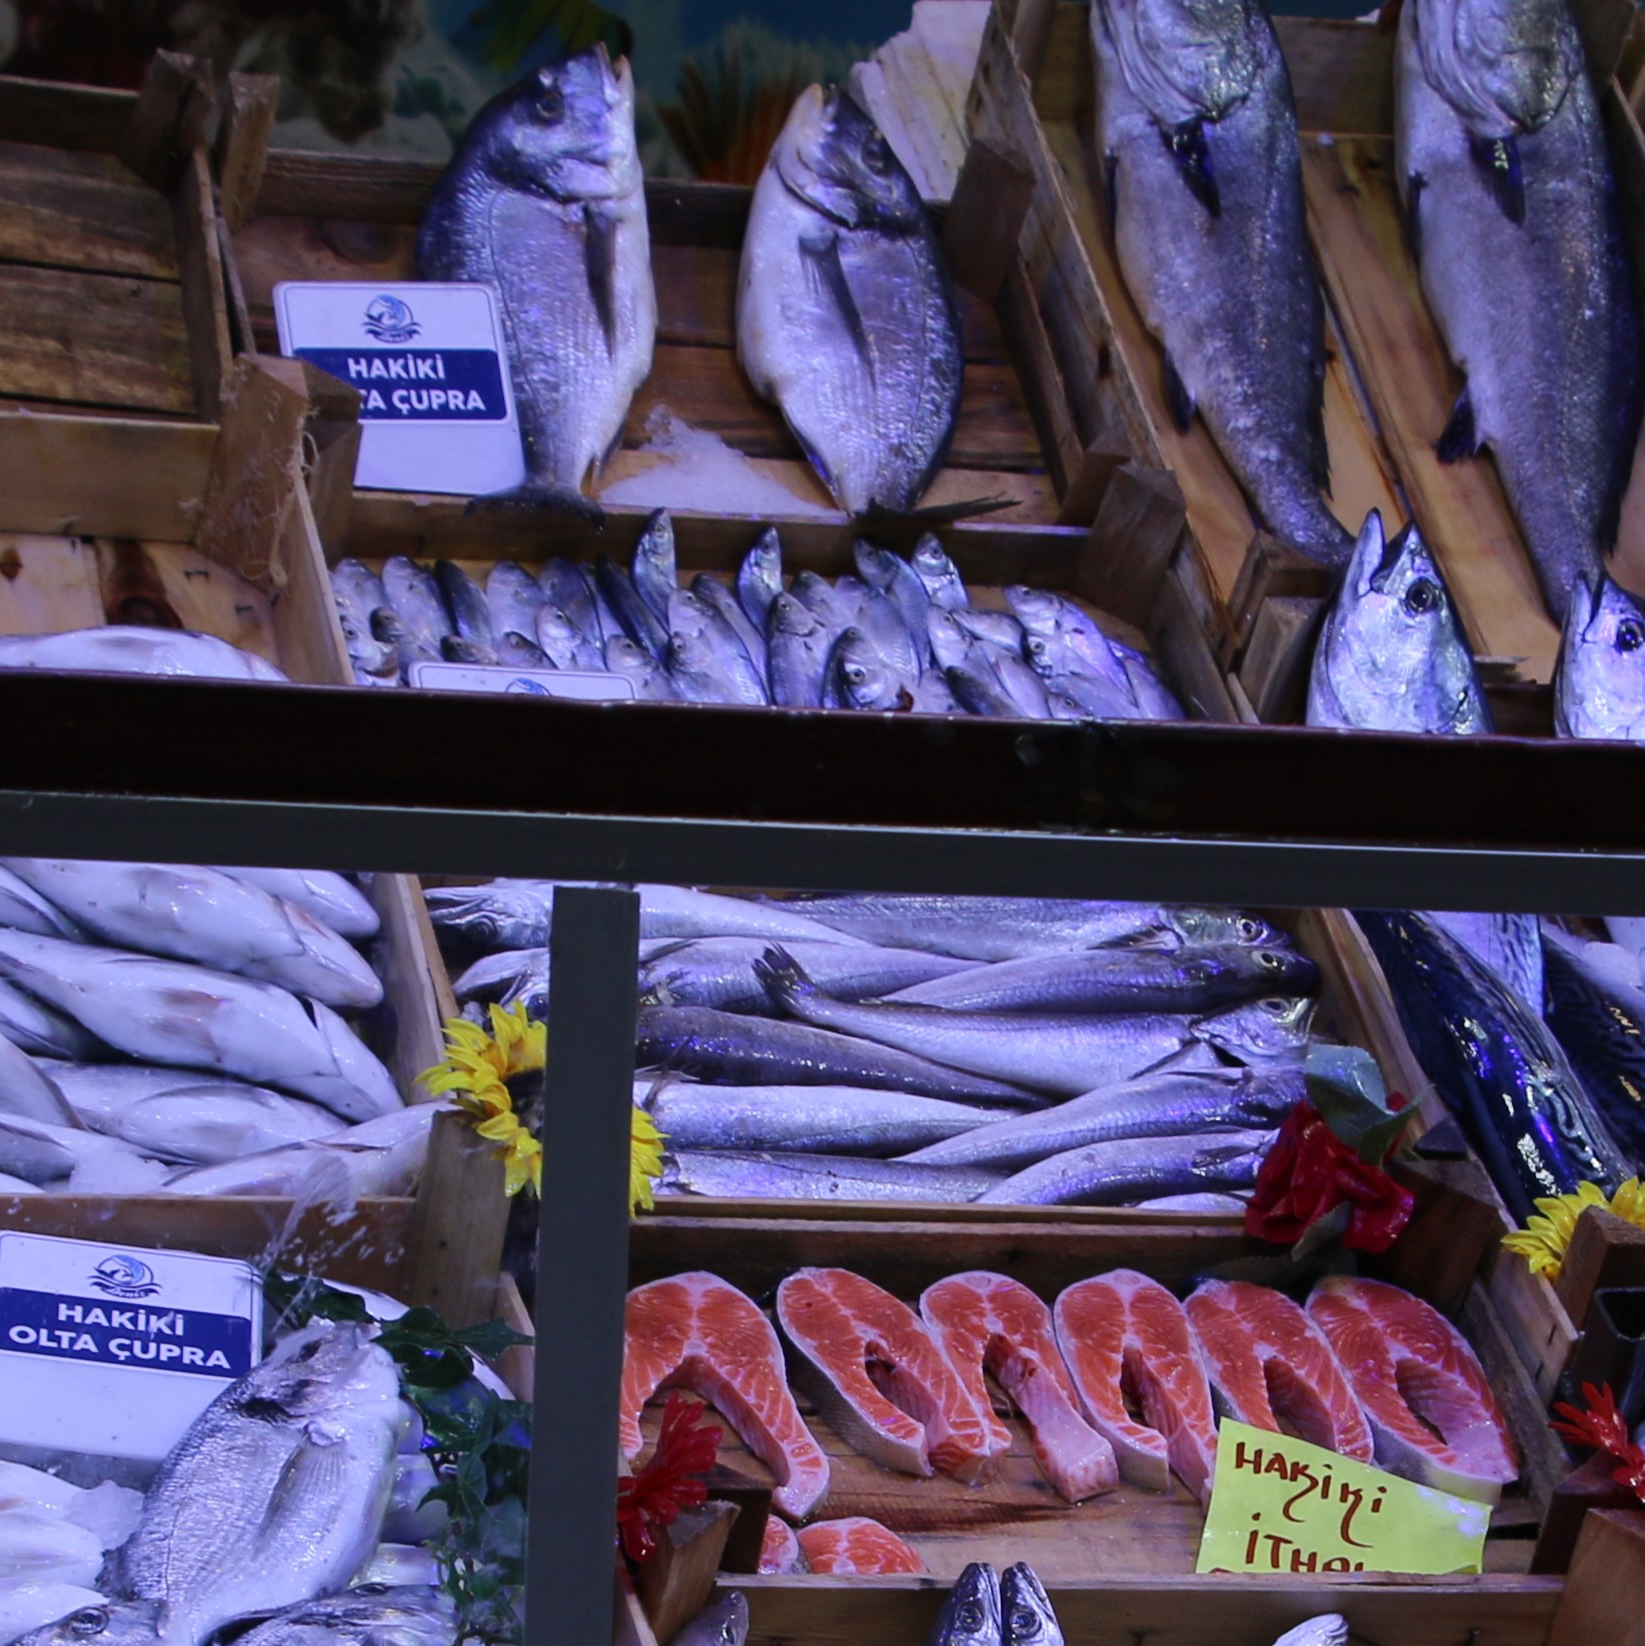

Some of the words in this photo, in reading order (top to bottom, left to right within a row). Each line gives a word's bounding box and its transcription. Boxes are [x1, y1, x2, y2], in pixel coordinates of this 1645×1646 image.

[347, 353, 446, 379] HAKİKİ
[391, 389, 486, 415] ÇUPRA
[57, 1302, 184, 1336] HAKİKİ
[8, 1325, 99, 1353] OLTA
[108, 1338, 231, 1369] ÇUPRA
[1234, 1441, 1388, 1548] HAKİKİ
[1245, 1512, 1364, 1573] İTHA
